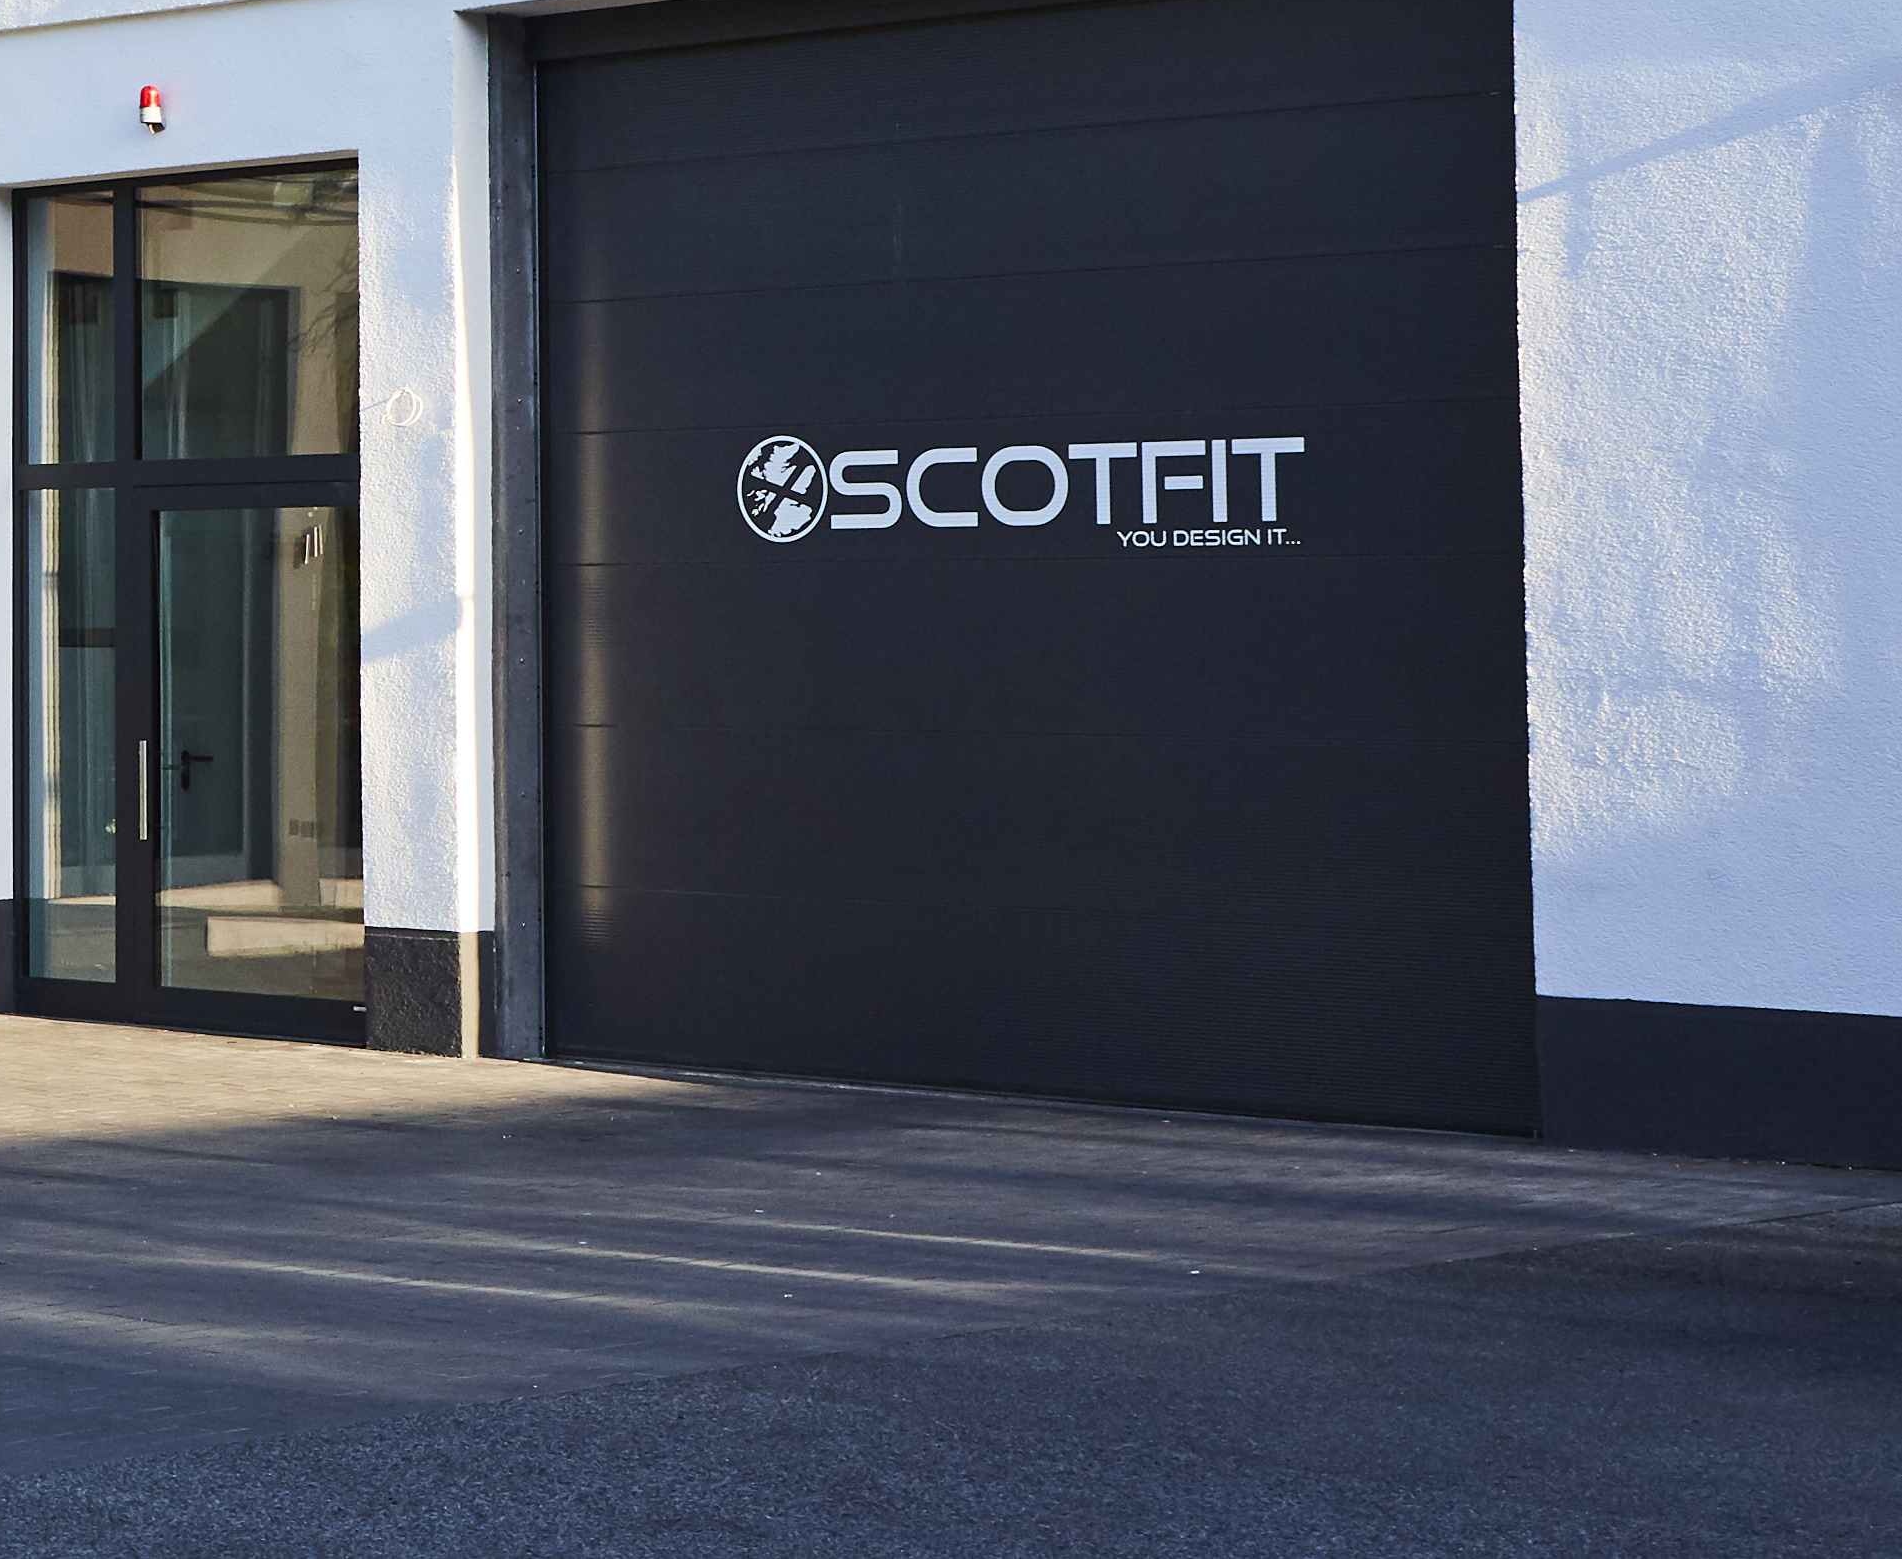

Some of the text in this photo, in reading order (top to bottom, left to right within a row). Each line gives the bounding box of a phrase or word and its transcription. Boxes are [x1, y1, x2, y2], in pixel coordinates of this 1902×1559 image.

[830, 437, 1305, 530] SCOTFIT
[1117, 530, 1168, 548] YOU
[1173, 528, 1261, 547] DESIGN
